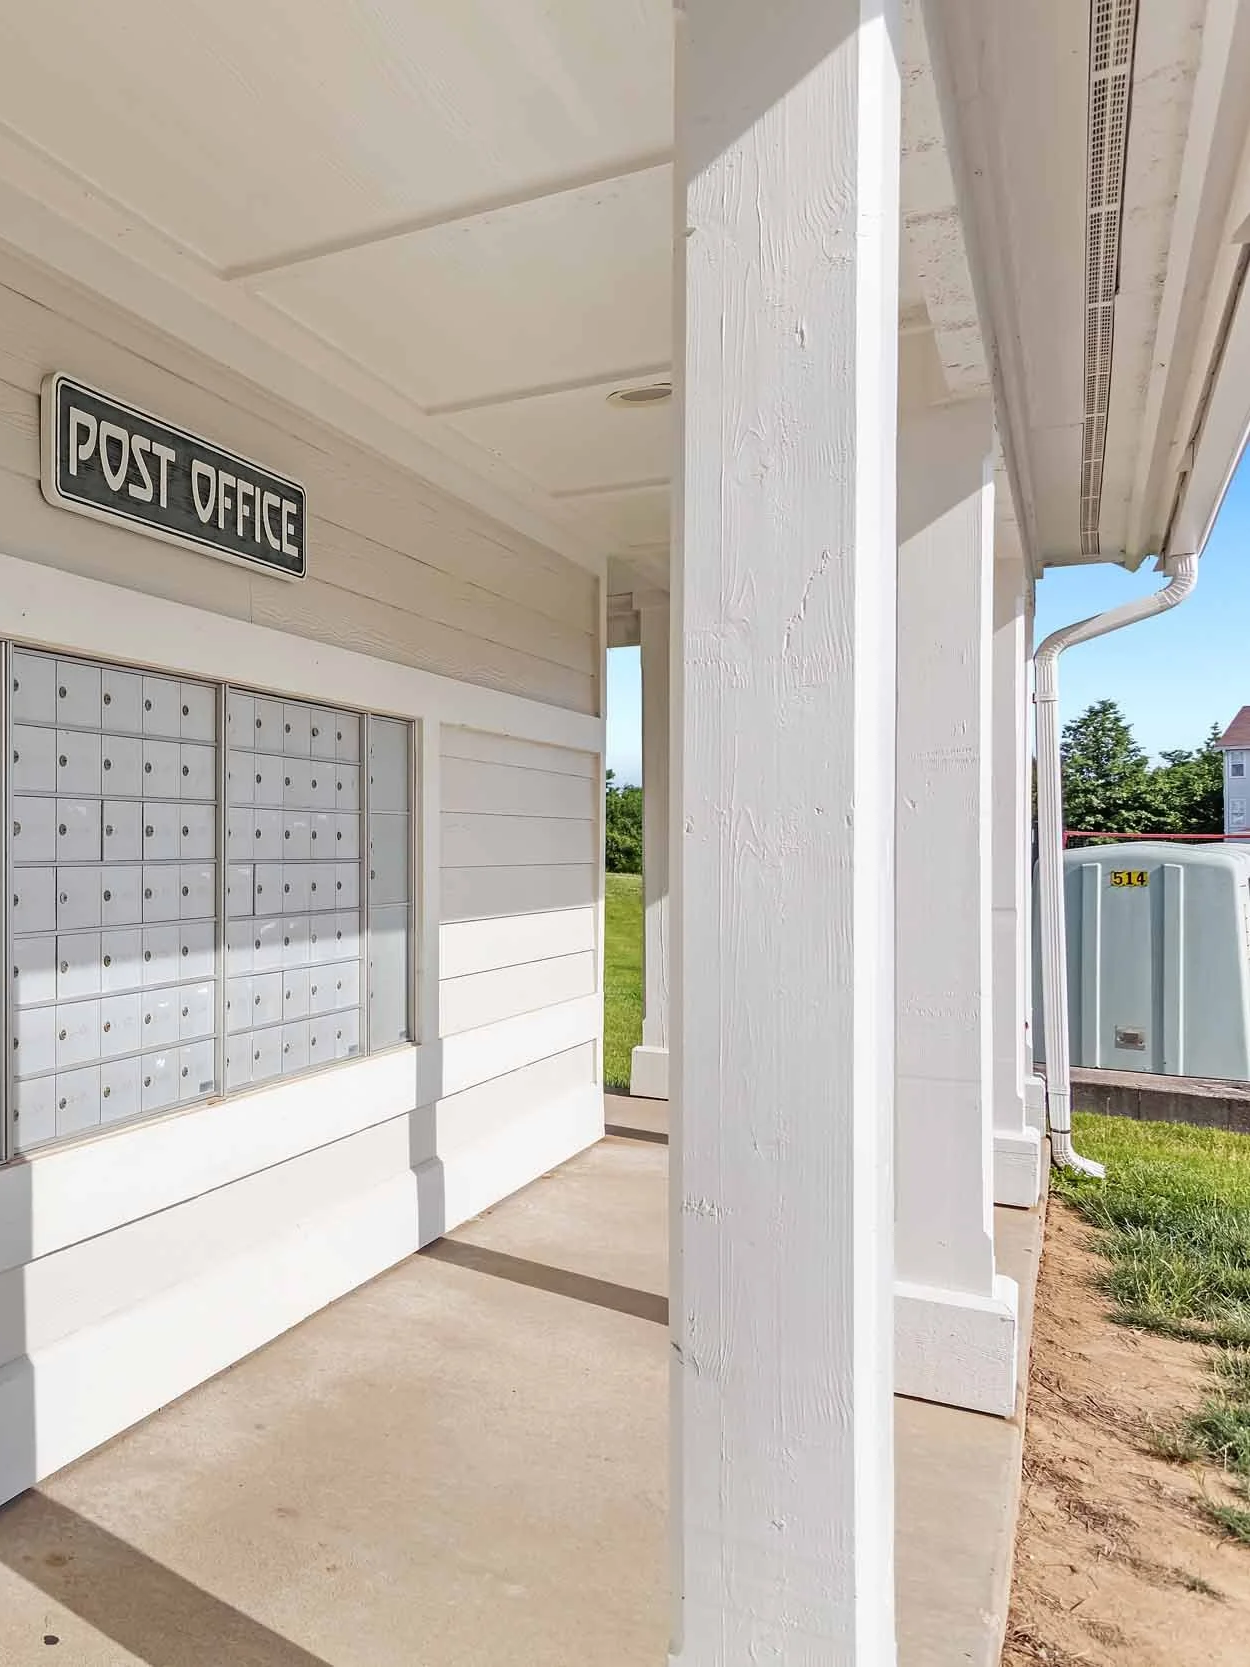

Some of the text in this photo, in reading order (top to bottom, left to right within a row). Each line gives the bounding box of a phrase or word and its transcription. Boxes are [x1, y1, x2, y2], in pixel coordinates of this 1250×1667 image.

[68, 406, 299, 557] POST OFFICE
[1113, 871, 1146, 886] 514
